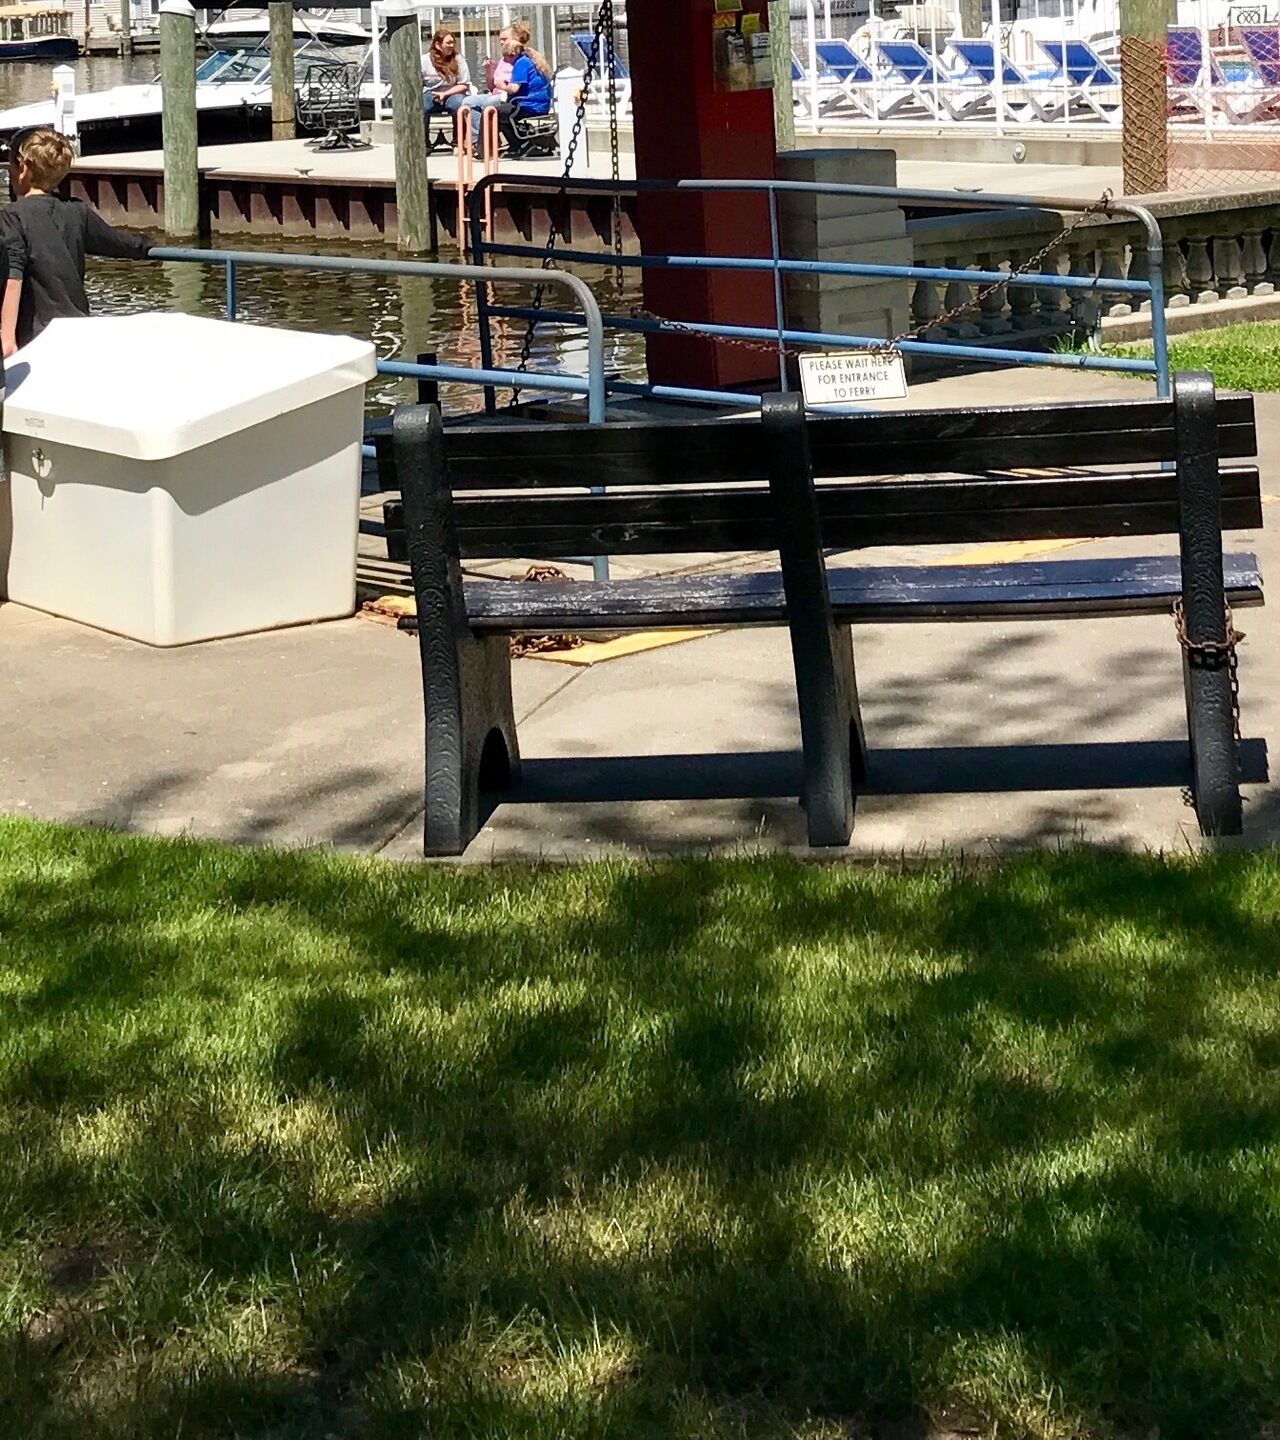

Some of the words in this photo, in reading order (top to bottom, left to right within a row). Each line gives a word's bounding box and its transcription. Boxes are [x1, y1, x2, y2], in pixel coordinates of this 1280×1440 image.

[810, 360, 842, 370] PLEASE
[846, 358, 868, 368] WAIT
[872, 356, 893, 367] HERE
[818, 374, 836, 384] FOR
[840, 371, 888, 383] ENTRANCE
[834, 388, 846, 398] TO
[849, 386, 876, 396] FERRY
